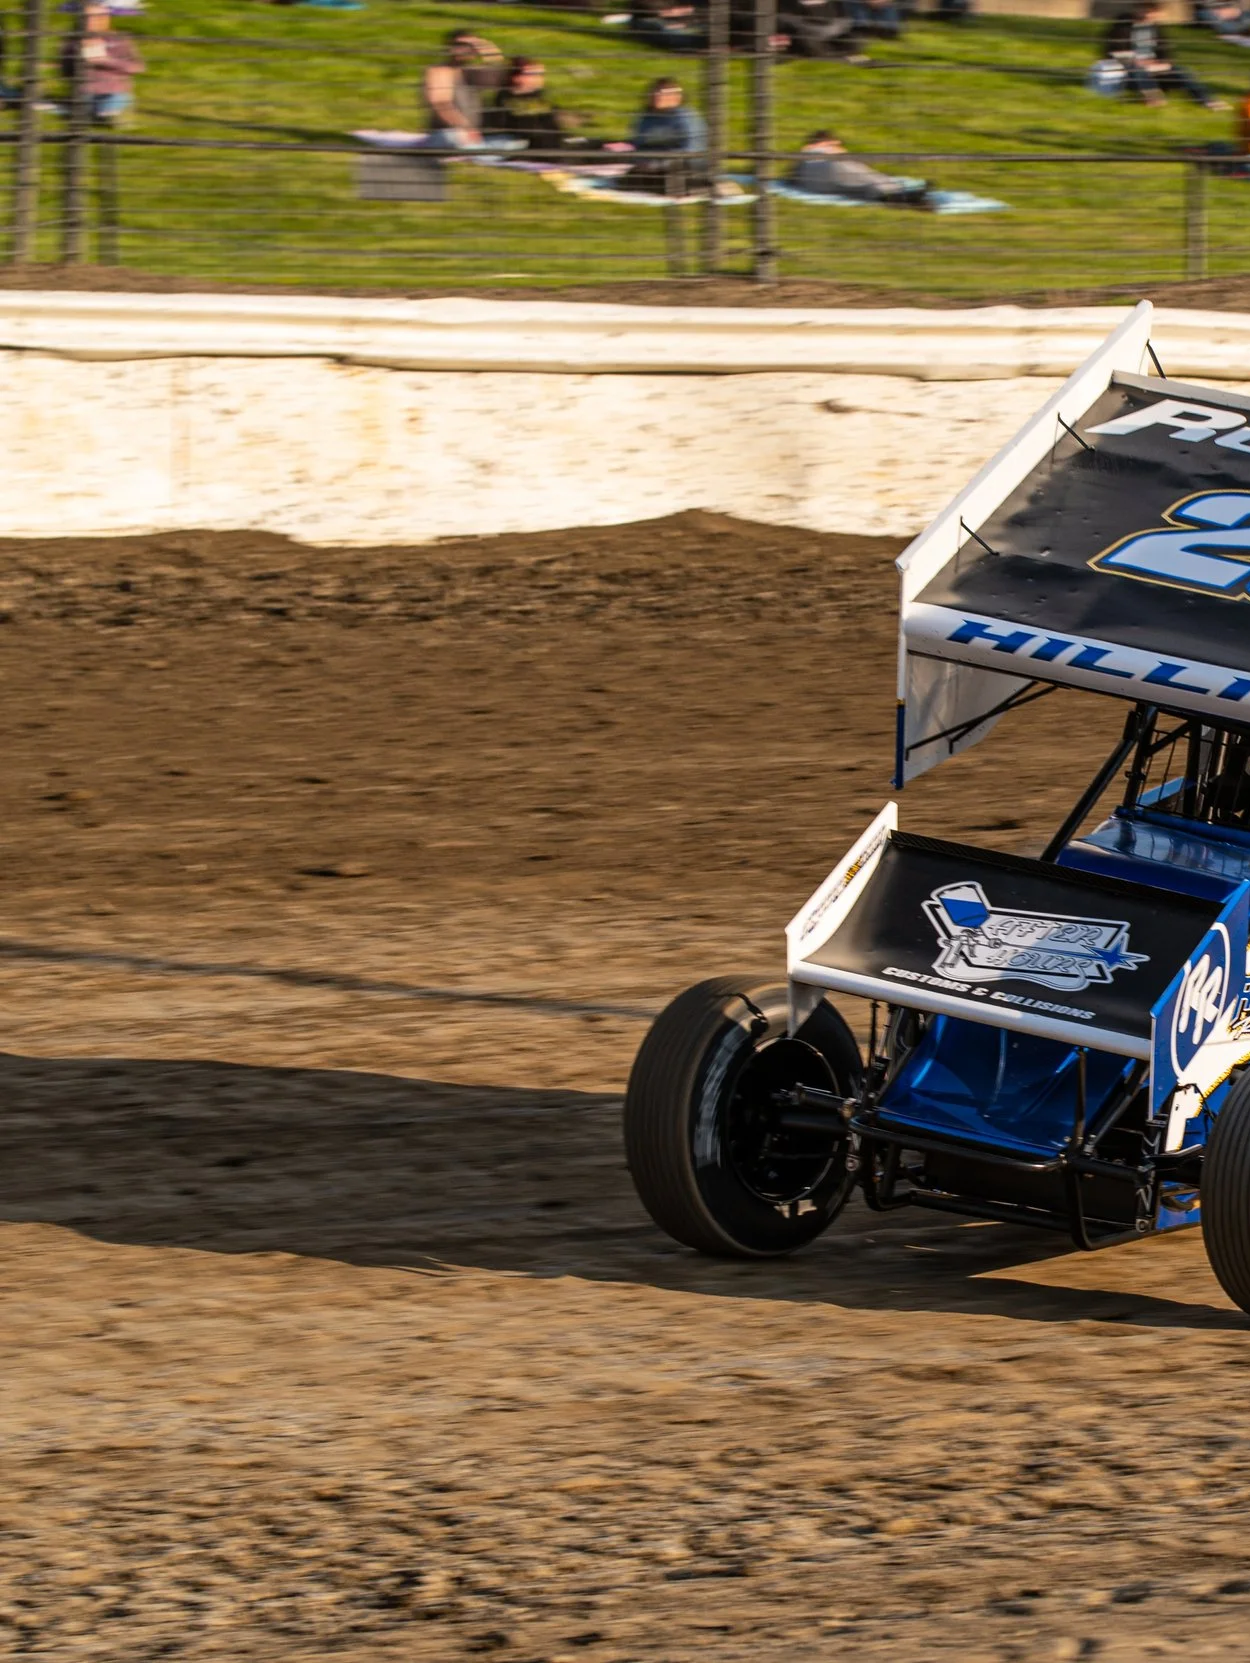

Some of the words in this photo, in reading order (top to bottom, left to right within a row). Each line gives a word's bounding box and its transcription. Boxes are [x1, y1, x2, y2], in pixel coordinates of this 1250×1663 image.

[987, 917, 1104, 947] AFTER
[985, 948, 1096, 978] HOURS
[881, 966, 972, 993] CUSTOMS
[971, 987, 989, 997] &
[988, 990, 1097, 1020] COLLISIONS
